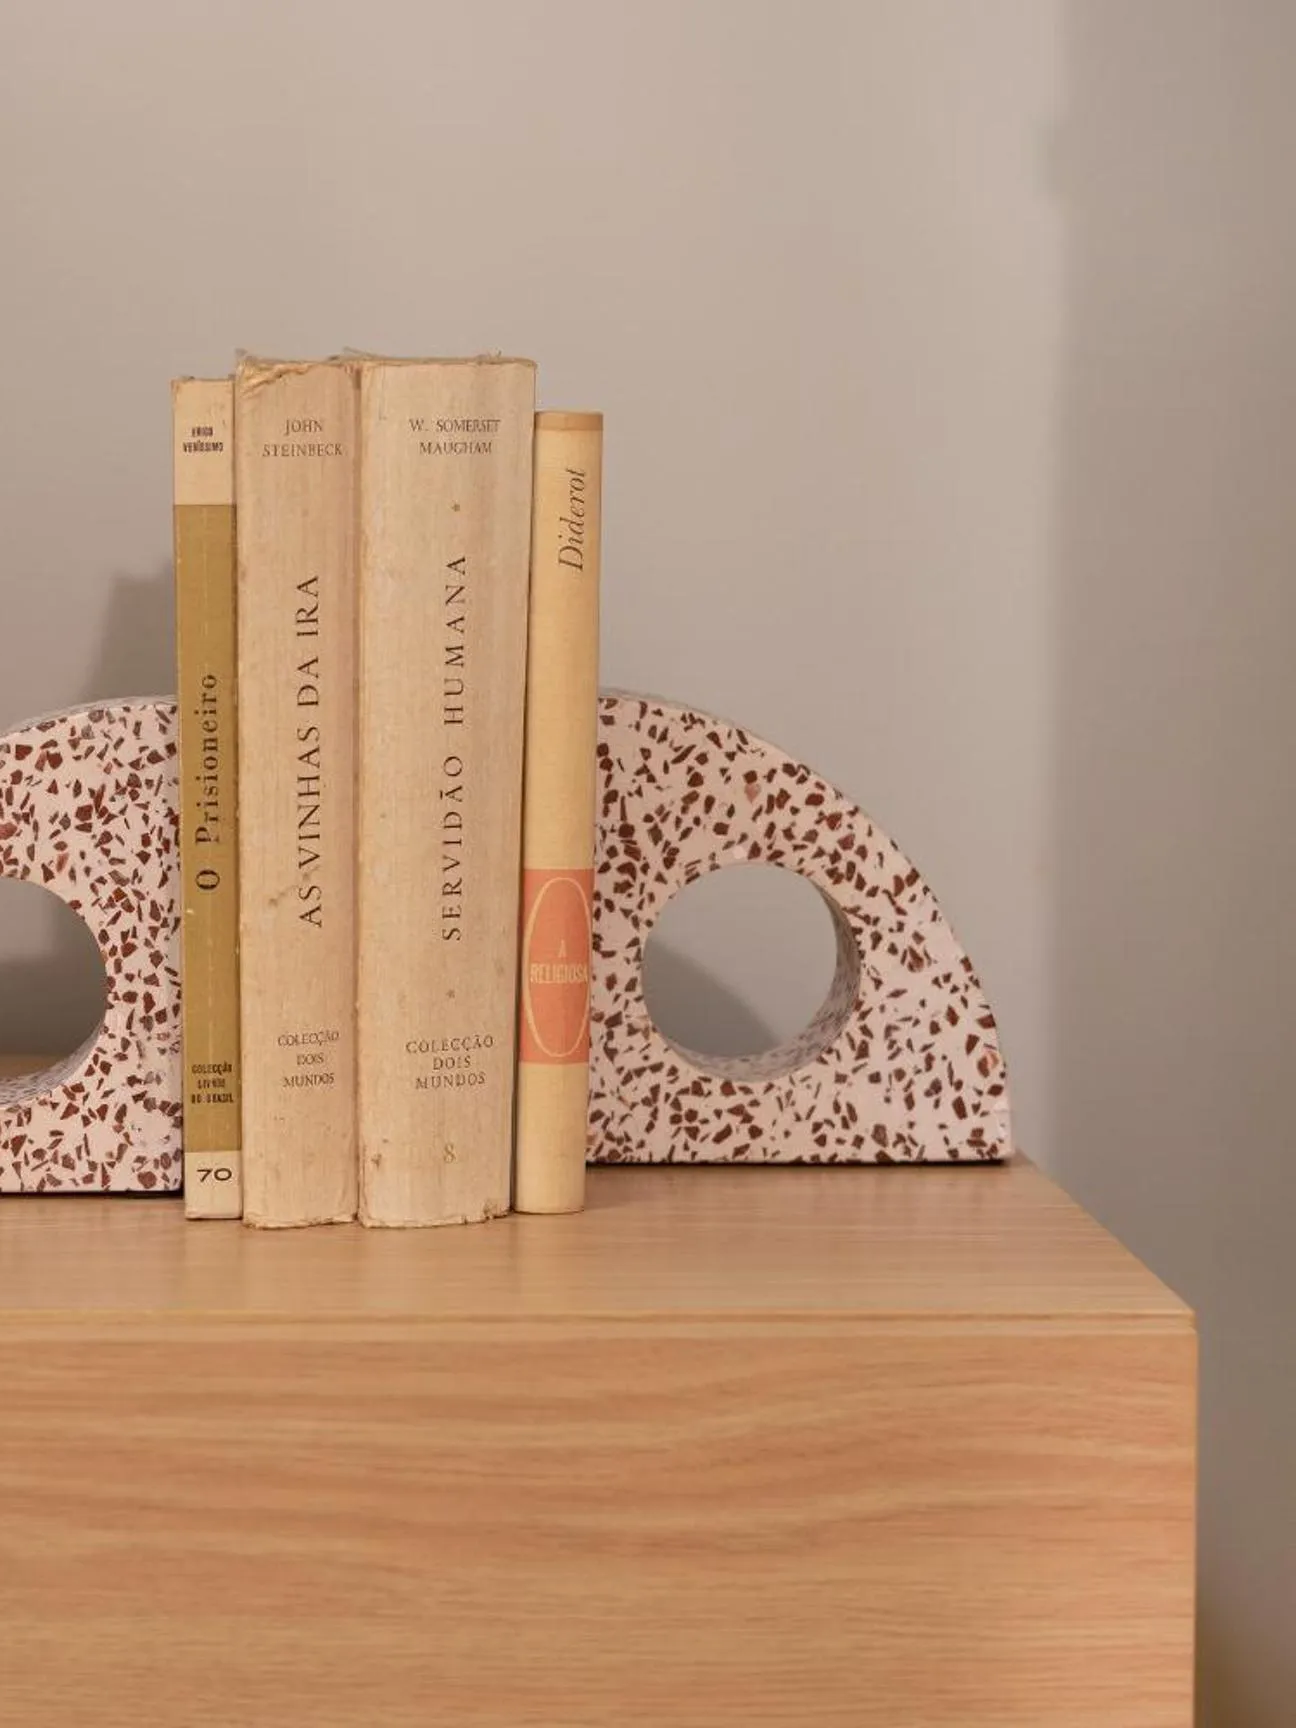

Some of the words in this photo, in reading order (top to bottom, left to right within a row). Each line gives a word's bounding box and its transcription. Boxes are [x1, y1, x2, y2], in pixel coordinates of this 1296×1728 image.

[283, 418, 324, 436] JOHN
[409, 418, 429, 433] W.
[435, 418, 502, 433] SOMERSET
[262, 443, 344, 457] STEINBECK
[419, 442, 493, 455] MAUGHAM
[557, 467, 588, 571] Diderot
[295, 575, 319, 637] IRA
[443, 556, 466, 726] HUMANA
[296, 656, 320, 707] DA
[193, 674, 221, 845] Prisioneiro
[297, 725, 322, 871] VINHAS
[439, 755, 464, 941] SERVIDÃO
[194, 868, 222, 892] O
[298, 883, 323, 928] AS
[277, 1029, 340, 1047] COLECÇÃO
[405, 1034, 494, 1054] COLECÇÃO
[296, 1052, 325, 1066] DOIS
[432, 1055, 471, 1071] DOIS
[283, 1072, 335, 1088] MUNDOS
[415, 1072, 487, 1090] MUNDOS
[442, 1142, 456, 1164] 8
[196, 1167, 233, 1183] 70
